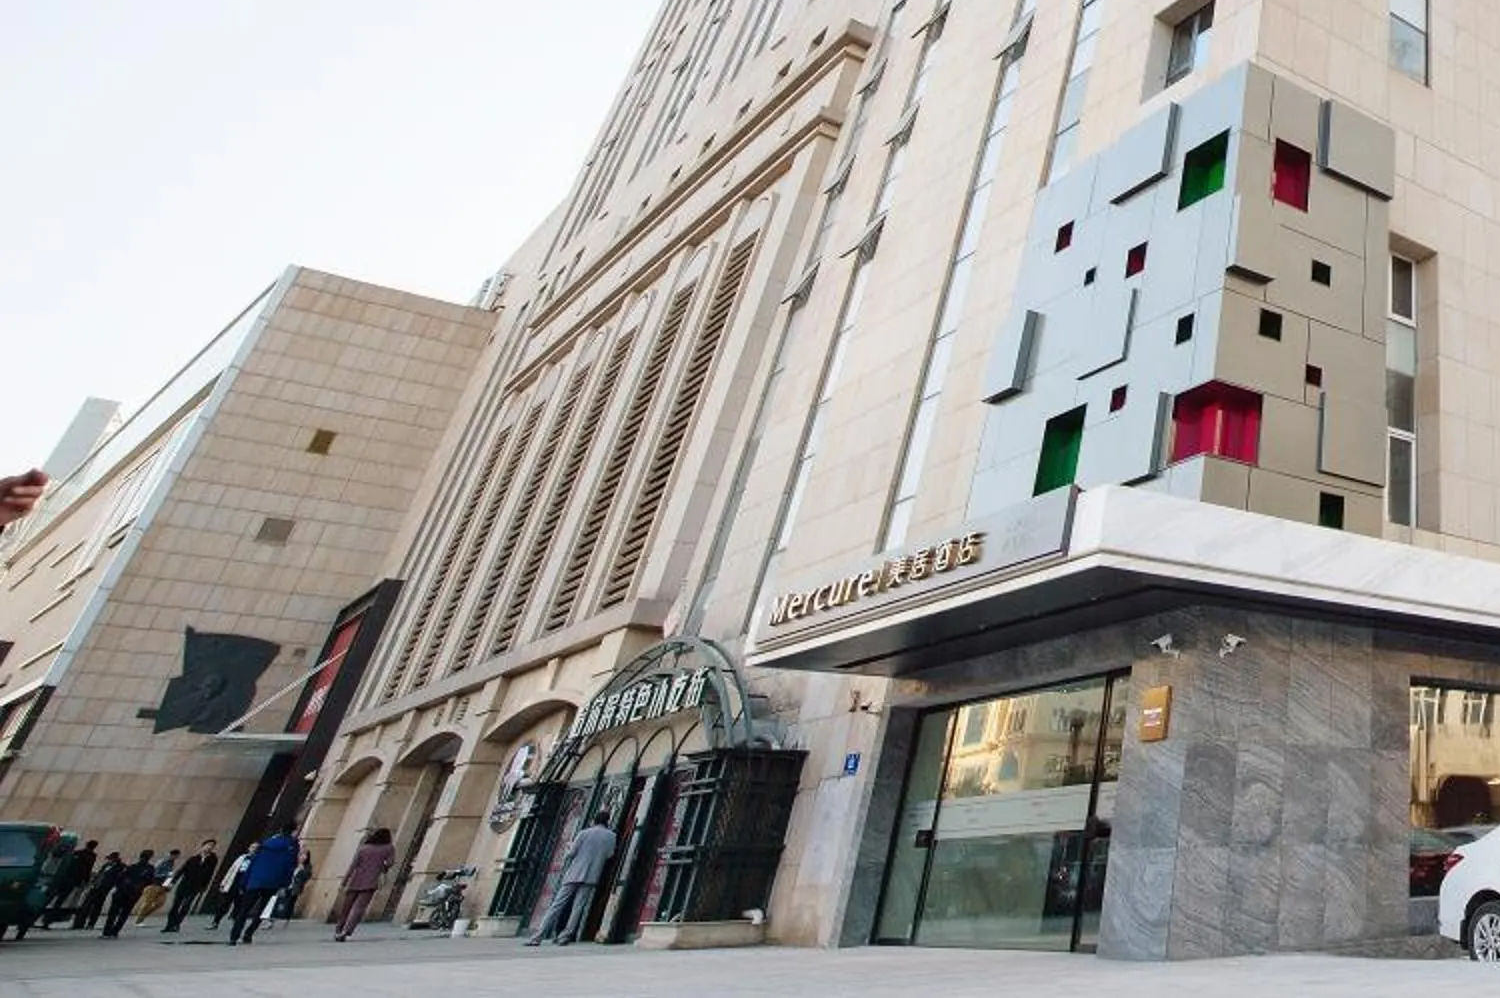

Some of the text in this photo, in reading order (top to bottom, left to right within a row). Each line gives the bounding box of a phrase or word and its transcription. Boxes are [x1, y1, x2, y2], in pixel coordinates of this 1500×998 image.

[886, 531, 983, 588] 美居酒店
[769, 569, 874, 626] Mercure
